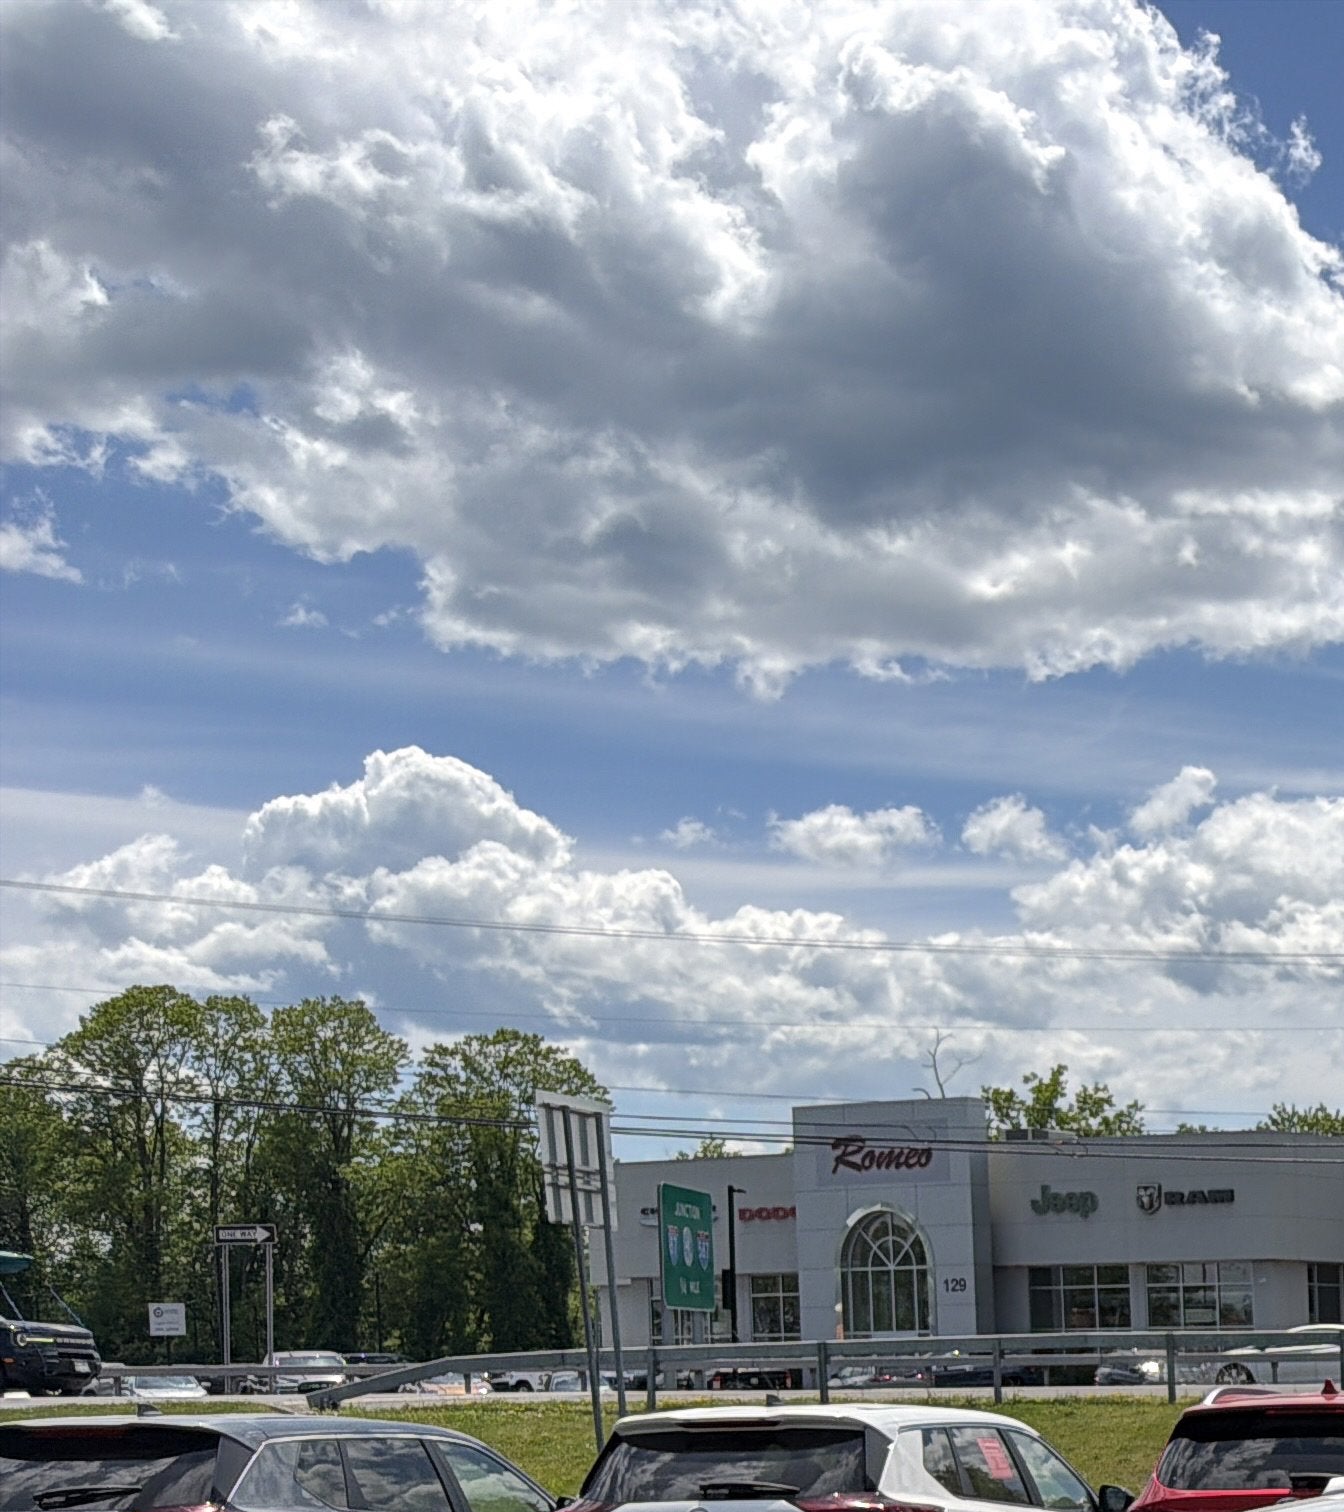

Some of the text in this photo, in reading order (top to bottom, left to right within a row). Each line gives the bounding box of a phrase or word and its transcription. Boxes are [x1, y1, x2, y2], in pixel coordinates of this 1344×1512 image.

[831, 1134, 934, 1175] Romeo
[1030, 1184, 1099, 1220] Jeep
[1164, 1188, 1235, 1206] RAM
[943, 1278, 967, 1293] 129
